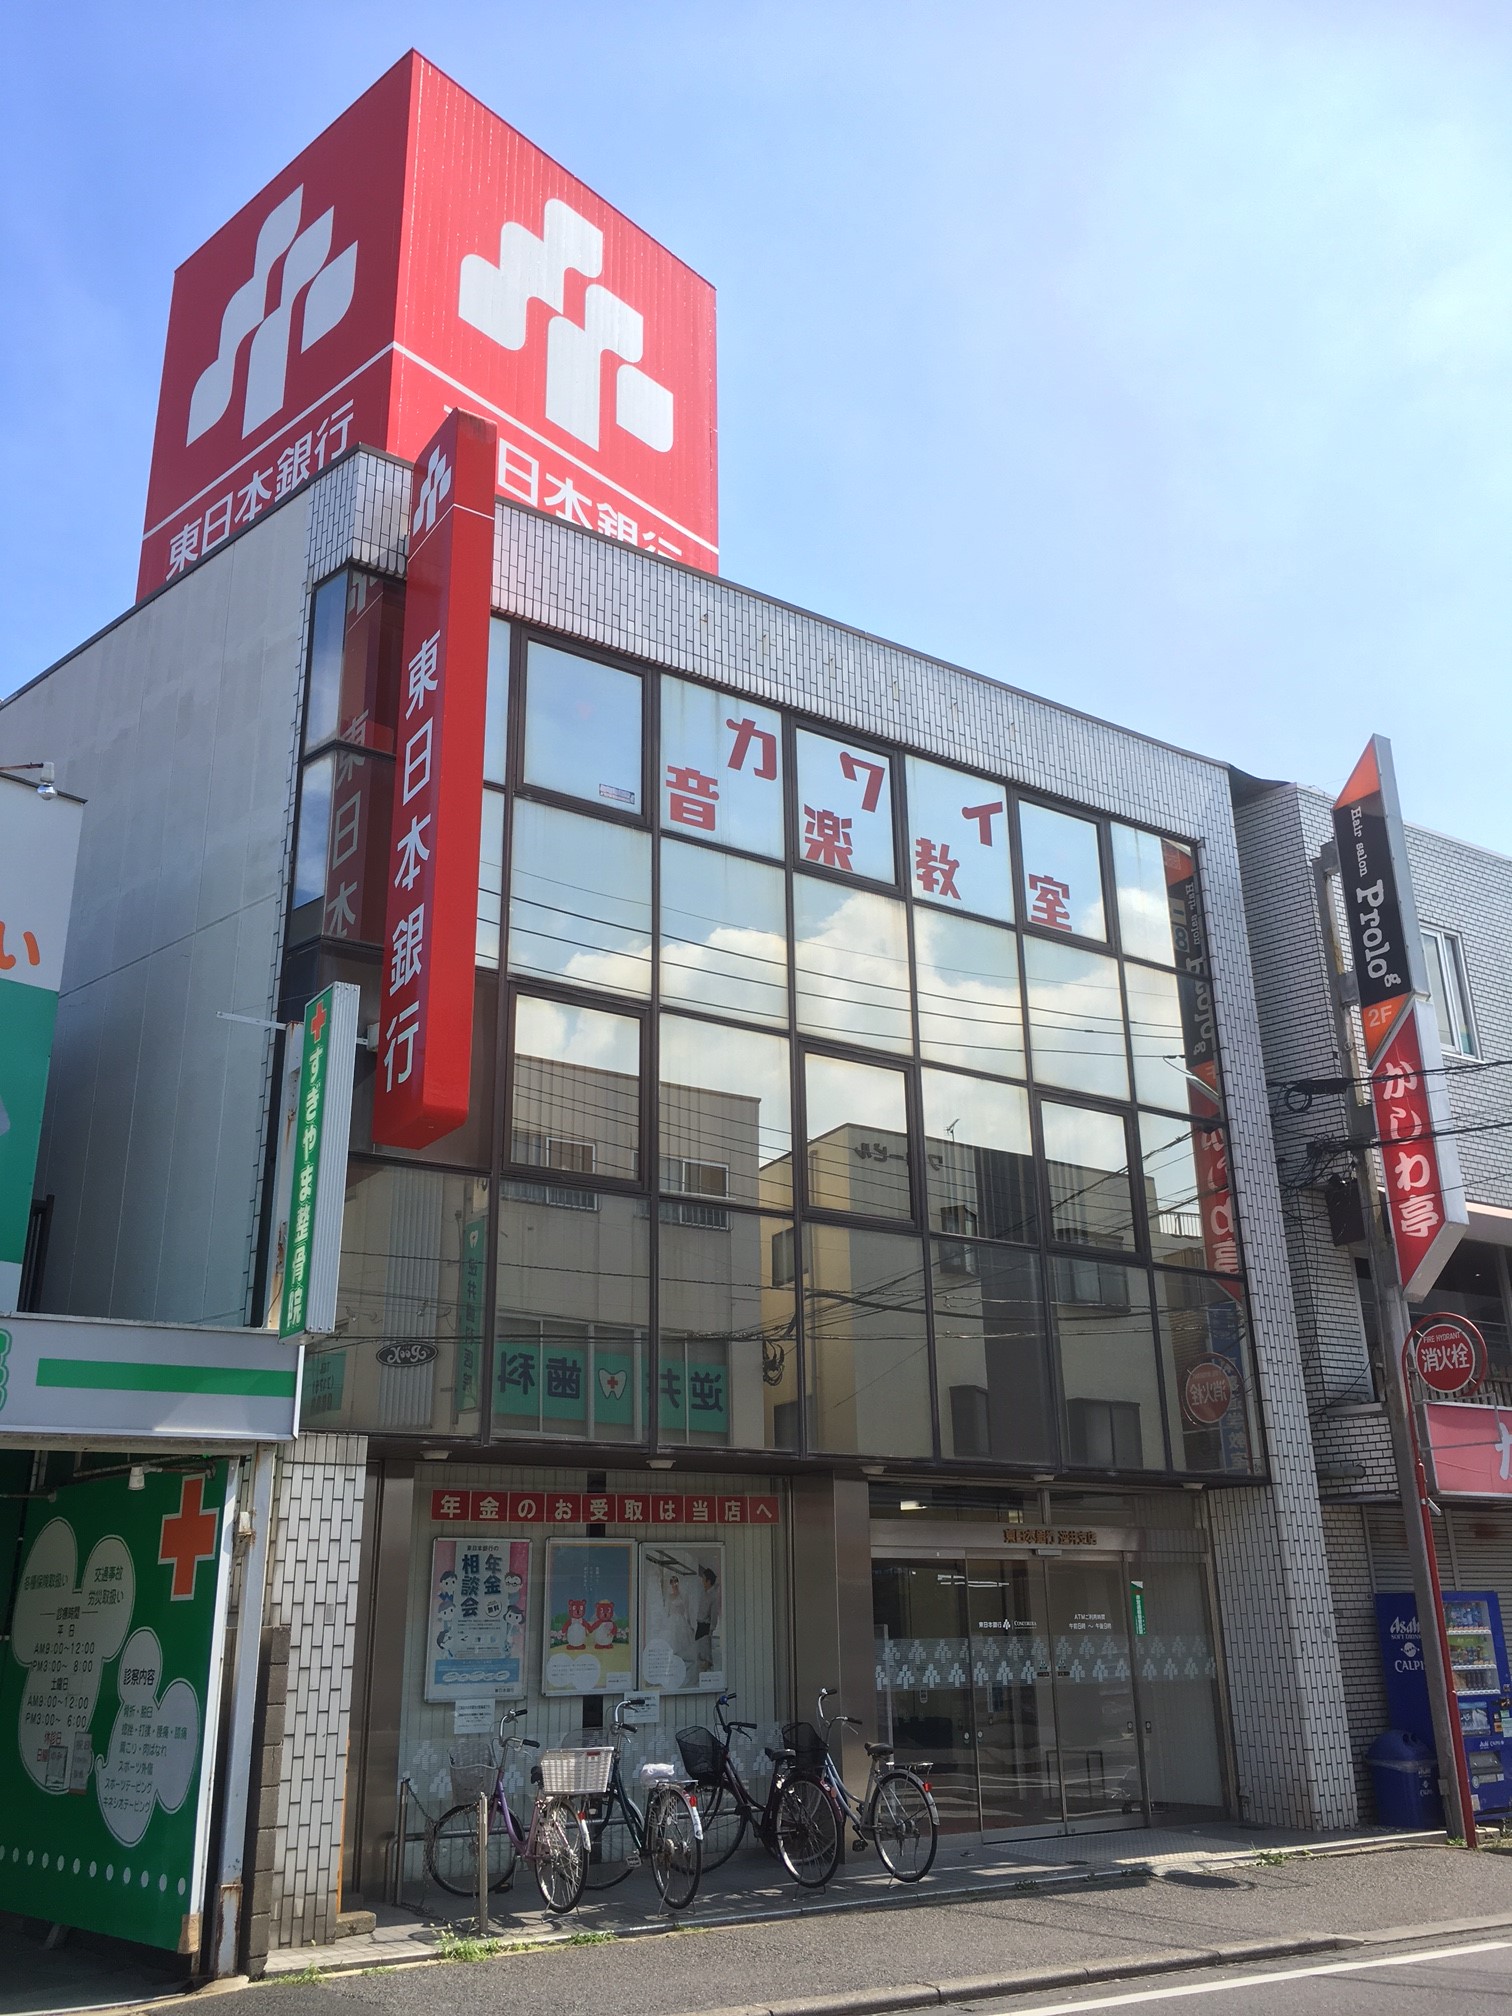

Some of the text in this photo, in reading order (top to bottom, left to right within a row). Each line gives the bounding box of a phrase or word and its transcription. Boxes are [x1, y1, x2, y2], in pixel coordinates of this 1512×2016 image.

[165, 399, 354, 581] 東日本銀行
[726, 717, 1004, 847] カワイ
[383, 629, 440, 1094] 東日本銀行
[666, 764, 1073, 932] 音楽教室
[1350, 806, 1369, 877] Hair salon
[1356, 879, 1402, 988] Prolog
[1368, 1004, 1393, 1028] 2F
[1383, 1061, 1439, 1238] かしわ亭
[1421, 1342, 1470, 1373] 消火栓
[1423, 1331, 1461, 1344] FIRE HYDRANT
[440, 1494, 773, 1523] 年金のお受取は当店へ
[460, 1554, 481, 1617] 相談会
[483, 1554, 503, 1595] 年金
[123, 1668, 156, 1686] 診察内容
